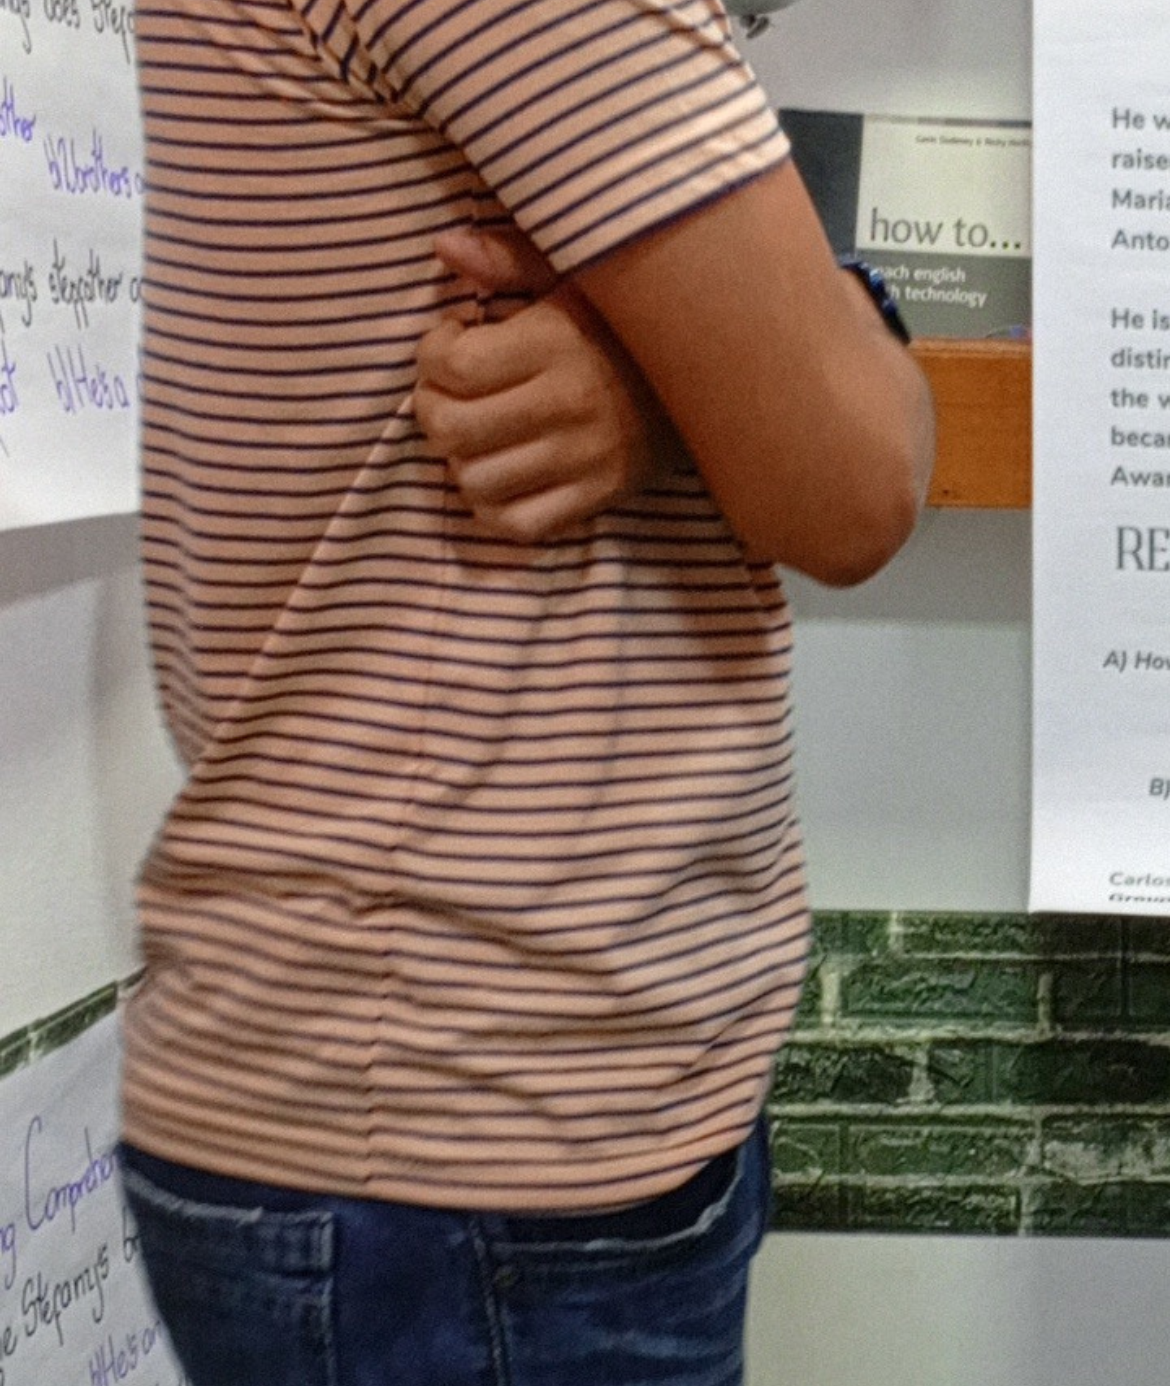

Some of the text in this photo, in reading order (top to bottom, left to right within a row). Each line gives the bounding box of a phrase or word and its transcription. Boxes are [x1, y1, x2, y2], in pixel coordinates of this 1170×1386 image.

[1112, 108, 1145, 130] He
[870, 207, 1022, 250] how to...
[914, 266, 966, 285] english
[905, 284, 988, 307] technology
[1111, 308, 1144, 329] He
[1110, 388, 1149, 408] the
[1103, 650, 1127, 671] A)
[25, 1115, 116, 1233] Comprehe
